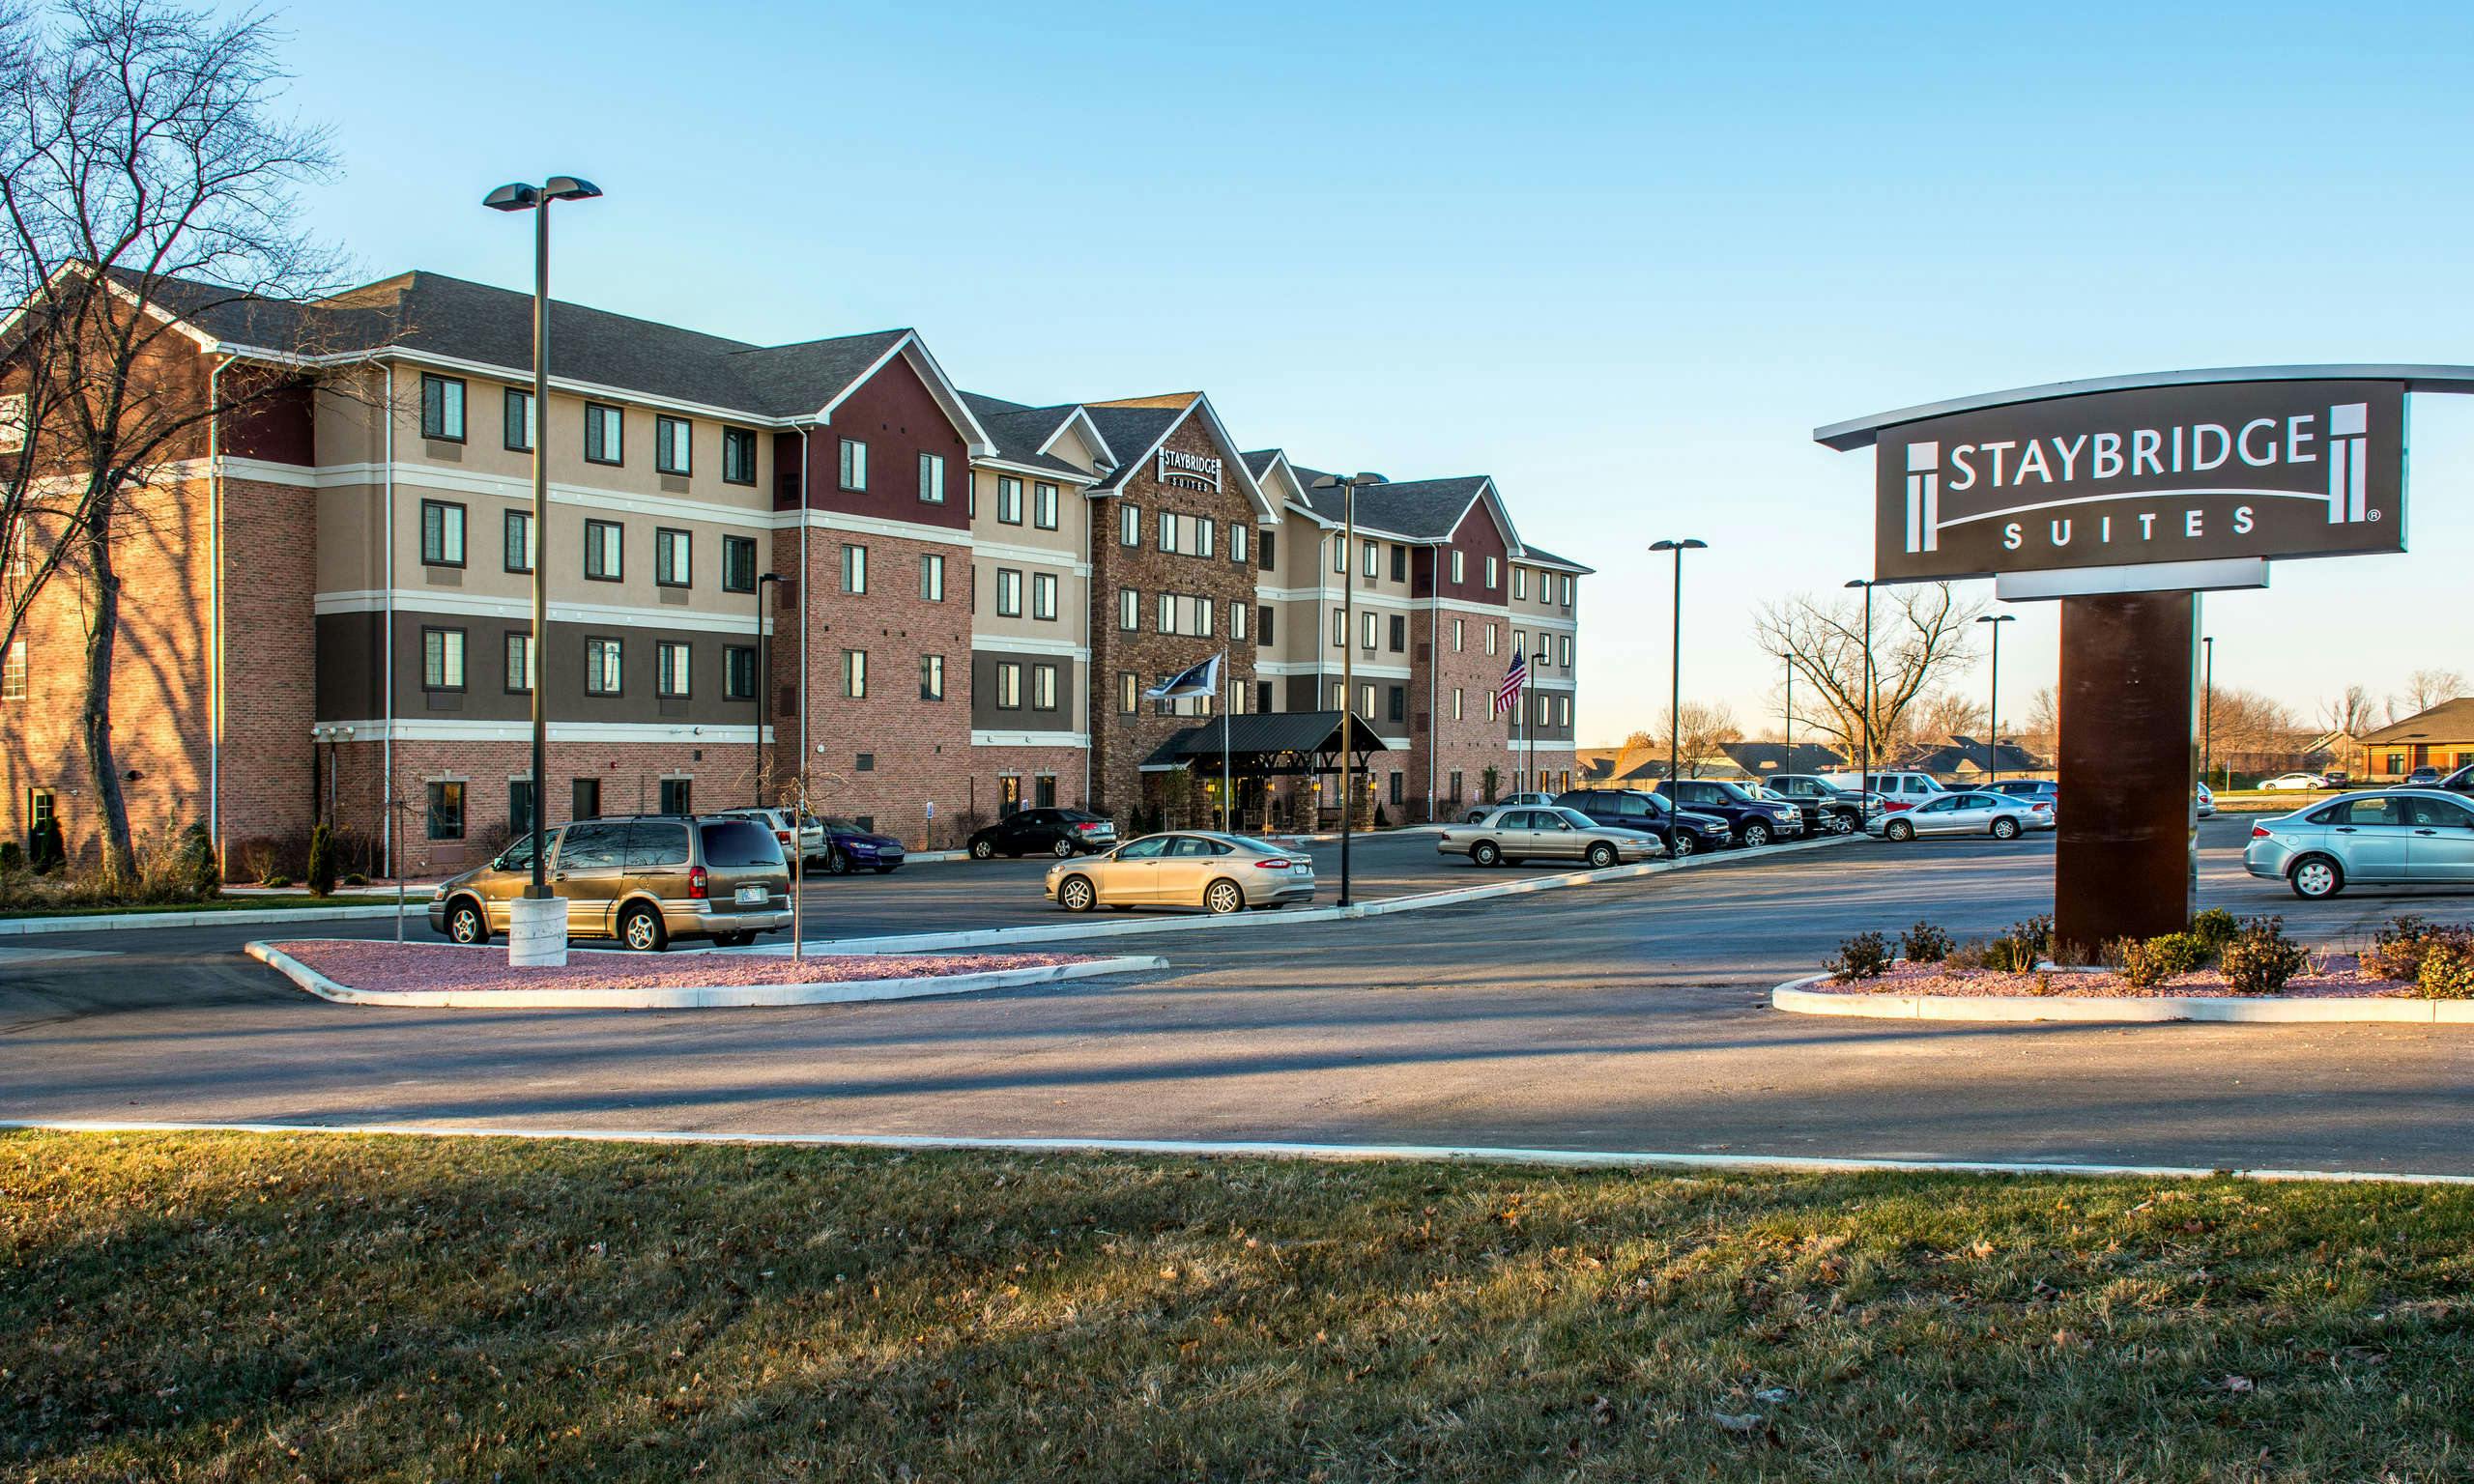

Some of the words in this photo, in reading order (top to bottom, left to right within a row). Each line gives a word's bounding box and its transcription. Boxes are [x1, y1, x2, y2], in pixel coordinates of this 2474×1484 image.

[1165, 450, 1216, 474] STAYBRIDGE
[1949, 414, 2316, 492] STAYBRIDGE
[1172, 478, 1207, 492] SUITES
[2003, 506, 2254, 550] SUITES
